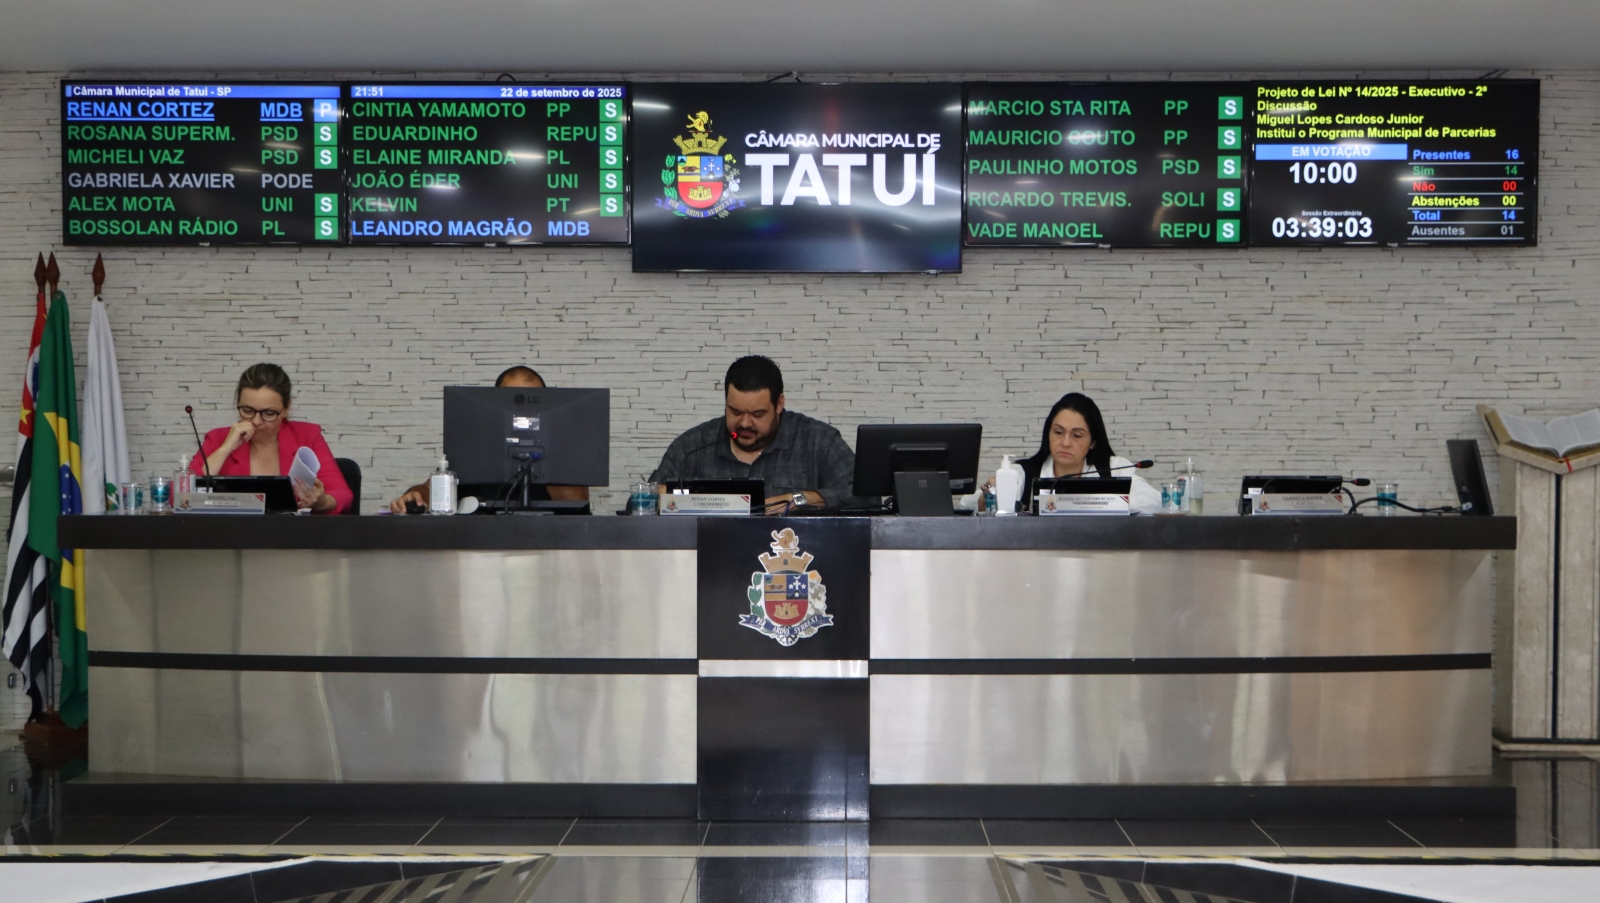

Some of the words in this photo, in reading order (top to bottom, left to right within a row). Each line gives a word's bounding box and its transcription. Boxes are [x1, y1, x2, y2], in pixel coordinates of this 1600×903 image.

[73, 86, 113, 96] Câmara
[115, 87, 164, 98] Municipal
[168, 87, 180, 96] de
[217, 87, 231, 96] SP
[355, 88, 383, 96] 21:51
[501, 88, 513, 97] 22
[516, 88, 529, 97] de
[532, 88, 579, 97] setembro
[582, 88, 595, 97] de
[598, 88, 622, 97] 2025
[1257, 87, 1298, 99] Projeto
[1302, 87, 1315, 97] de
[1319, 87, 1335, 97] Lei
[1355, 87, 1398, 97] 14/2025
[1409, 87, 1465, 96] Executivo
[67, 102, 131, 117] RENAN
[138, 102, 214, 117] CORTEZ
[260, 102, 302, 117] MDB
[320, 103, 331, 117] P
[352, 102, 413, 117] CINTIA
[418, 102, 526, 117] YAMAMOTO
[547, 103, 570, 117] PP
[605, 102, 617, 117] S
[969, 101, 1044, 115] MARCIO
[1050, 100, 1085, 115] STA
[1091, 101, 1131, 115] RITA
[1164, 101, 1188, 115] PP
[1225, 100, 1237, 115] S
[1257, 100, 1317, 111] Discussão
[1257, 114, 1295, 126] Miguel
[1298, 114, 1332, 126] Lopes
[1335, 114, 1384, 124] Cardoso
[1387, 114, 1424, 124] Junior
[68, 126, 146, 141] ROSANA
[151, 126, 235, 141] SUPERM.
[261, 126, 298, 141] PSD
[320, 126, 331, 141] S
[353, 126, 477, 141] EDUARDINHO
[547, 127, 597, 141] REPU
[605, 126, 617, 141] S
[745, 130, 819, 148] CÂMARA
[822, 134, 914, 147] MUNICIPAL
[918, 134, 940, 147] DE
[970, 130, 1062, 145] MAURICIO
[1069, 130, 1135, 145] COUTO
[1164, 131, 1188, 144] PP
[1224, 130, 1236, 145] S
[1257, 128, 1298, 138] Institui
[1298, 130, 1305, 138] o
[1309, 128, 1364, 140] Programa
[1368, 127, 1422, 140] Municipal
[1425, 127, 1439, 138] de
[1442, 127, 1496, 138] Parcerias
[68, 150, 143, 164] MICHELI
[150, 150, 184, 164] VAZ
[261, 150, 298, 165] PSD
[320, 150, 332, 165] S
[353, 150, 421, 165] ELAINE
[428, 150, 516, 165] MIRANDA
[547, 151, 570, 164] PL
[605, 150, 617, 165] S
[1292, 147, 1309, 156] EM
[1312, 146, 1371, 158] VOTAÇÃO
[1413, 150, 1470, 161] Presentes
[1505, 150, 1519, 160] 16
[969, 159, 1063, 175] PAULINHO
[1070, 159, 1137, 175] MOTOS
[1162, 160, 1199, 174] PSD
[1223, 159, 1235, 174] S
[1289, 162, 1357, 183] 10:00
[1413, 166, 1434, 176] Sim
[1505, 166, 1518, 175] 14
[69, 173, 163, 188] GABRIELA
[168, 174, 235, 188] XAVIER
[261, 174, 312, 188] PODE
[352, 170, 403, 189] JOÃO
[410, 170, 460, 188] ÉDER
[547, 174, 578, 188] UNI
[605, 174, 617, 189] S
[745, 148, 940, 206] TATUÍ
[1413, 181, 1435, 191] Não
[1503, 181, 1516, 191] 00
[69, 197, 117, 211] ALEX
[123, 197, 175, 212] MOTA
[262, 198, 292, 212] UNI
[320, 197, 332, 212] S
[352, 198, 417, 212] KELVIN
[547, 198, 570, 212] PT
[605, 197, 617, 212] S
[969, 192, 1054, 207] RICARDO
[1061, 192, 1132, 207] TREVIS.
[1161, 192, 1204, 207] SOLI
[1223, 191, 1234, 207] S
[1412, 196, 1479, 207] Abstenções
[1502, 196, 1516, 206] 00
[1413, 211, 1440, 220] Total
[1502, 211, 1515, 220] 14
[70, 220, 173, 235] BOSSOLAN
[179, 217, 238, 235] RÁDIO
[263, 222, 285, 235] PL
[321, 221, 332, 236] S
[352, 221, 442, 236] LEANDRO
[448, 217, 532, 236] MAGRÃO
[548, 221, 590, 236] MDB
[968, 223, 1017, 237] VADE
[1023, 223, 1102, 238] MANOEL
[1160, 224, 1210, 238] REPU
[1222, 223, 1234, 238] S
[1272, 217, 1372, 237] 03:39:03
[1412, 225, 1465, 236] Ausentes
[1501, 225, 1513, 235] 01
[527, 396, 540, 404] LG
